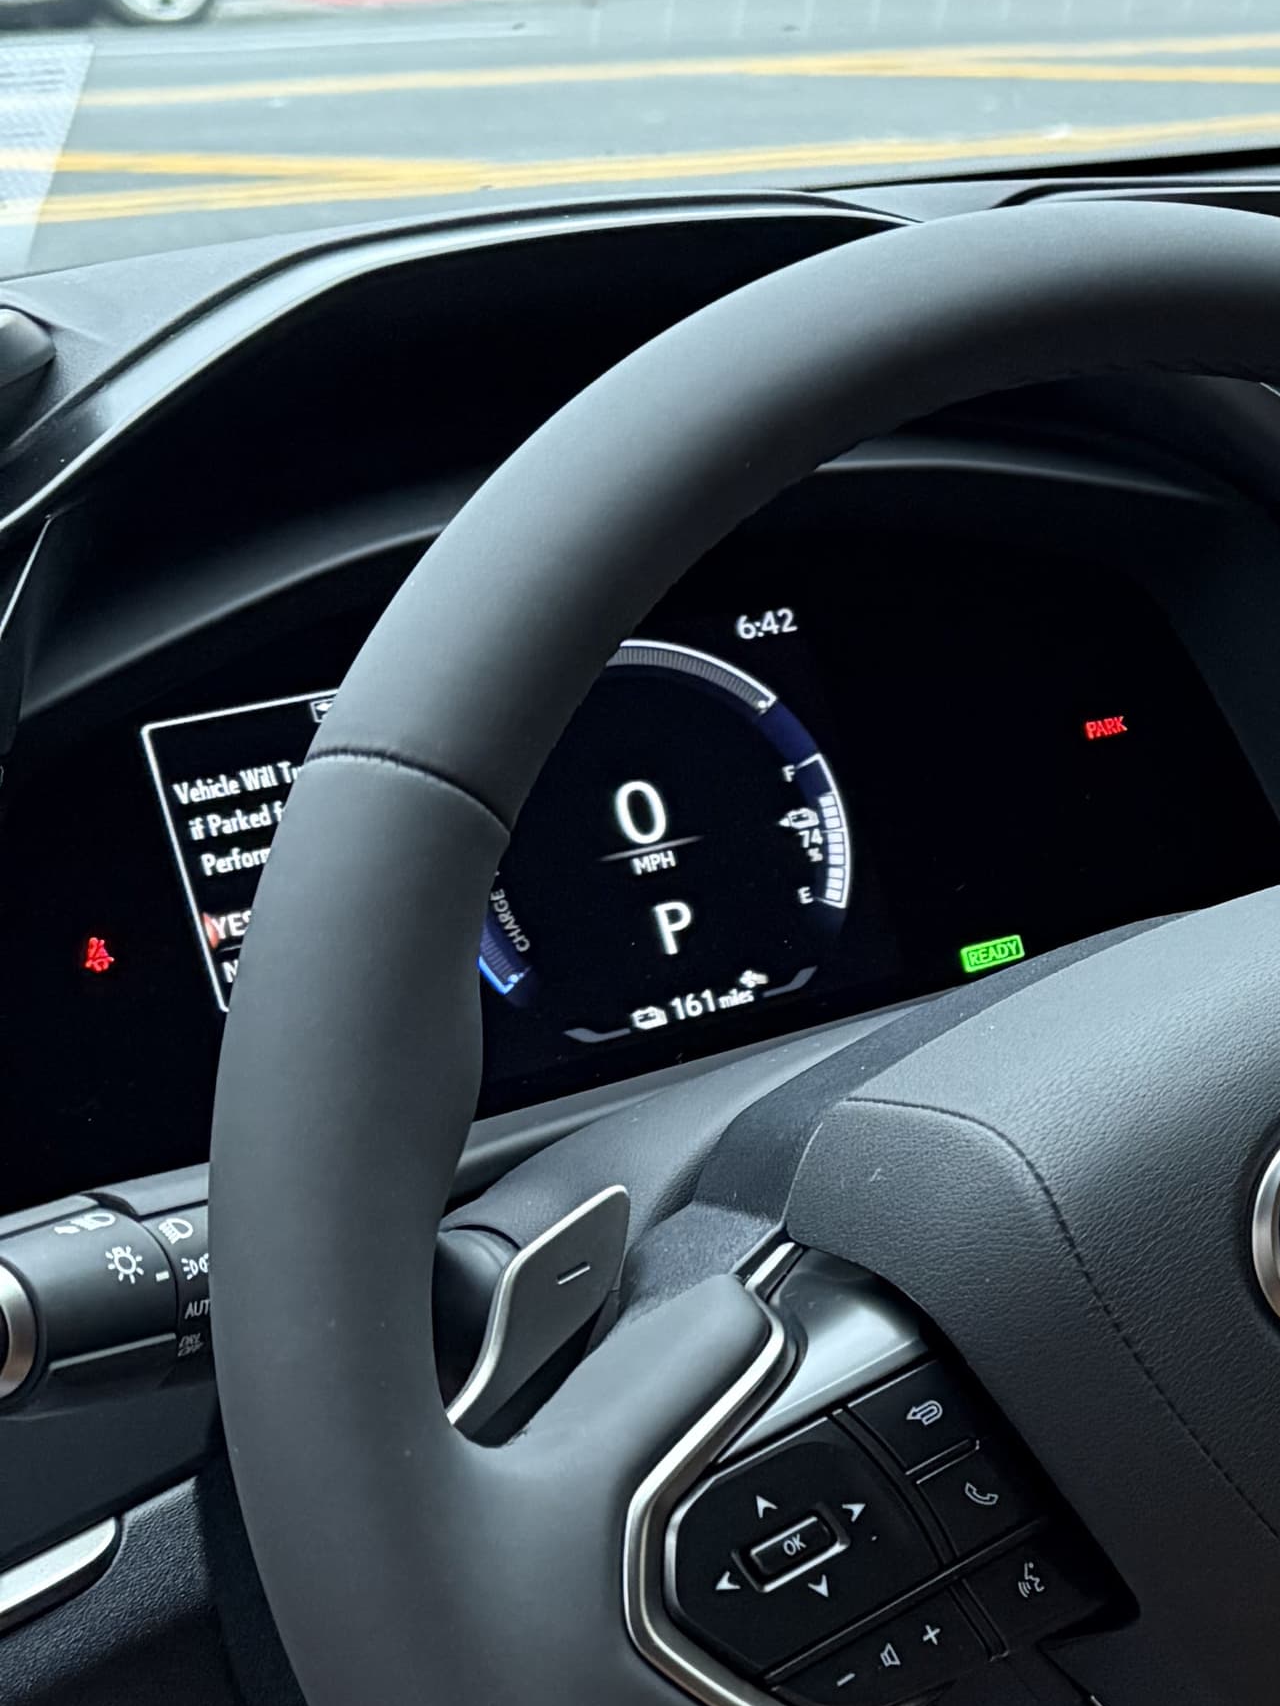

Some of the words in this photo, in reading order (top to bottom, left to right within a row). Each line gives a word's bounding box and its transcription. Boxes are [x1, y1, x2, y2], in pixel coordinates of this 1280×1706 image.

[736, 608, 798, 639] 6:42
[1085, 715, 1128, 740] PARK
[172, 774, 241, 805] Vehicle
[239, 765, 277, 792] Will
[782, 765, 796, 782] F
[188, 817, 204, 841] if
[206, 804, 272, 837] Parked
[615, 780, 668, 844] 0
[799, 828, 823, 848] 74
[632, 850, 676, 875] MPH
[798, 887, 813, 904] E
[490, 888, 530, 952] CHARGE
[654, 901, 691, 955] P
[968, 940, 1018, 967] READY
[668, 989, 716, 1020] 161
[718, 987, 755, 1010] miles
[783, 1533, 807, 1556] OK
